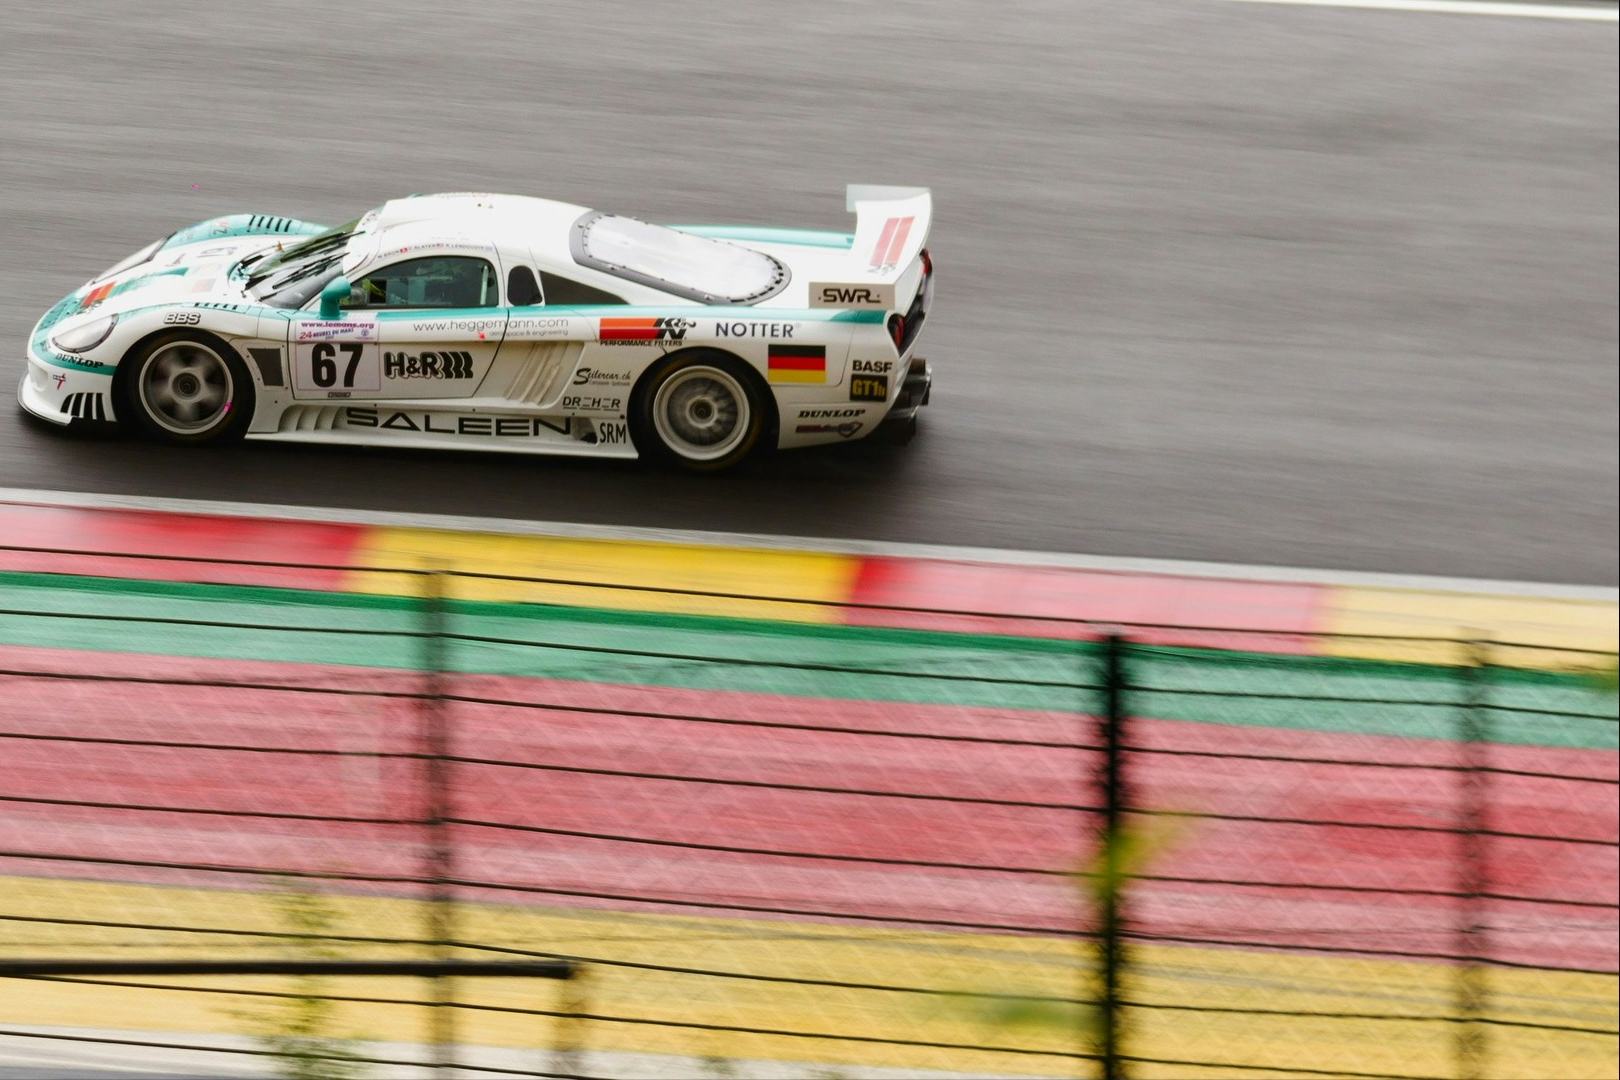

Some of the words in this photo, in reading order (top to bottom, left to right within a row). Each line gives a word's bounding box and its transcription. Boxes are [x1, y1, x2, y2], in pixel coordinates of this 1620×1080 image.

[823, 288, 882, 304] SWR
[163, 312, 201, 325] BBS
[301, 321, 375, 330] www.lemans.org
[413, 318, 569, 332] www.heggemann.com
[299, 331, 313, 340] 24
[715, 322, 794, 338] NOTTER
[599, 339, 653, 347] PERFORMANCE
[654, 339, 683, 347] FILTERS
[55, 352, 105, 369] DUNLOP
[311, 342, 364, 388] 67
[383, 351, 444, 380] H&R
[852, 360, 893, 373] BASF
[797, 408, 866, 419] DUNLOP
[346, 406, 572, 437] SALEEN
[599, 421, 627, 445] SRM
